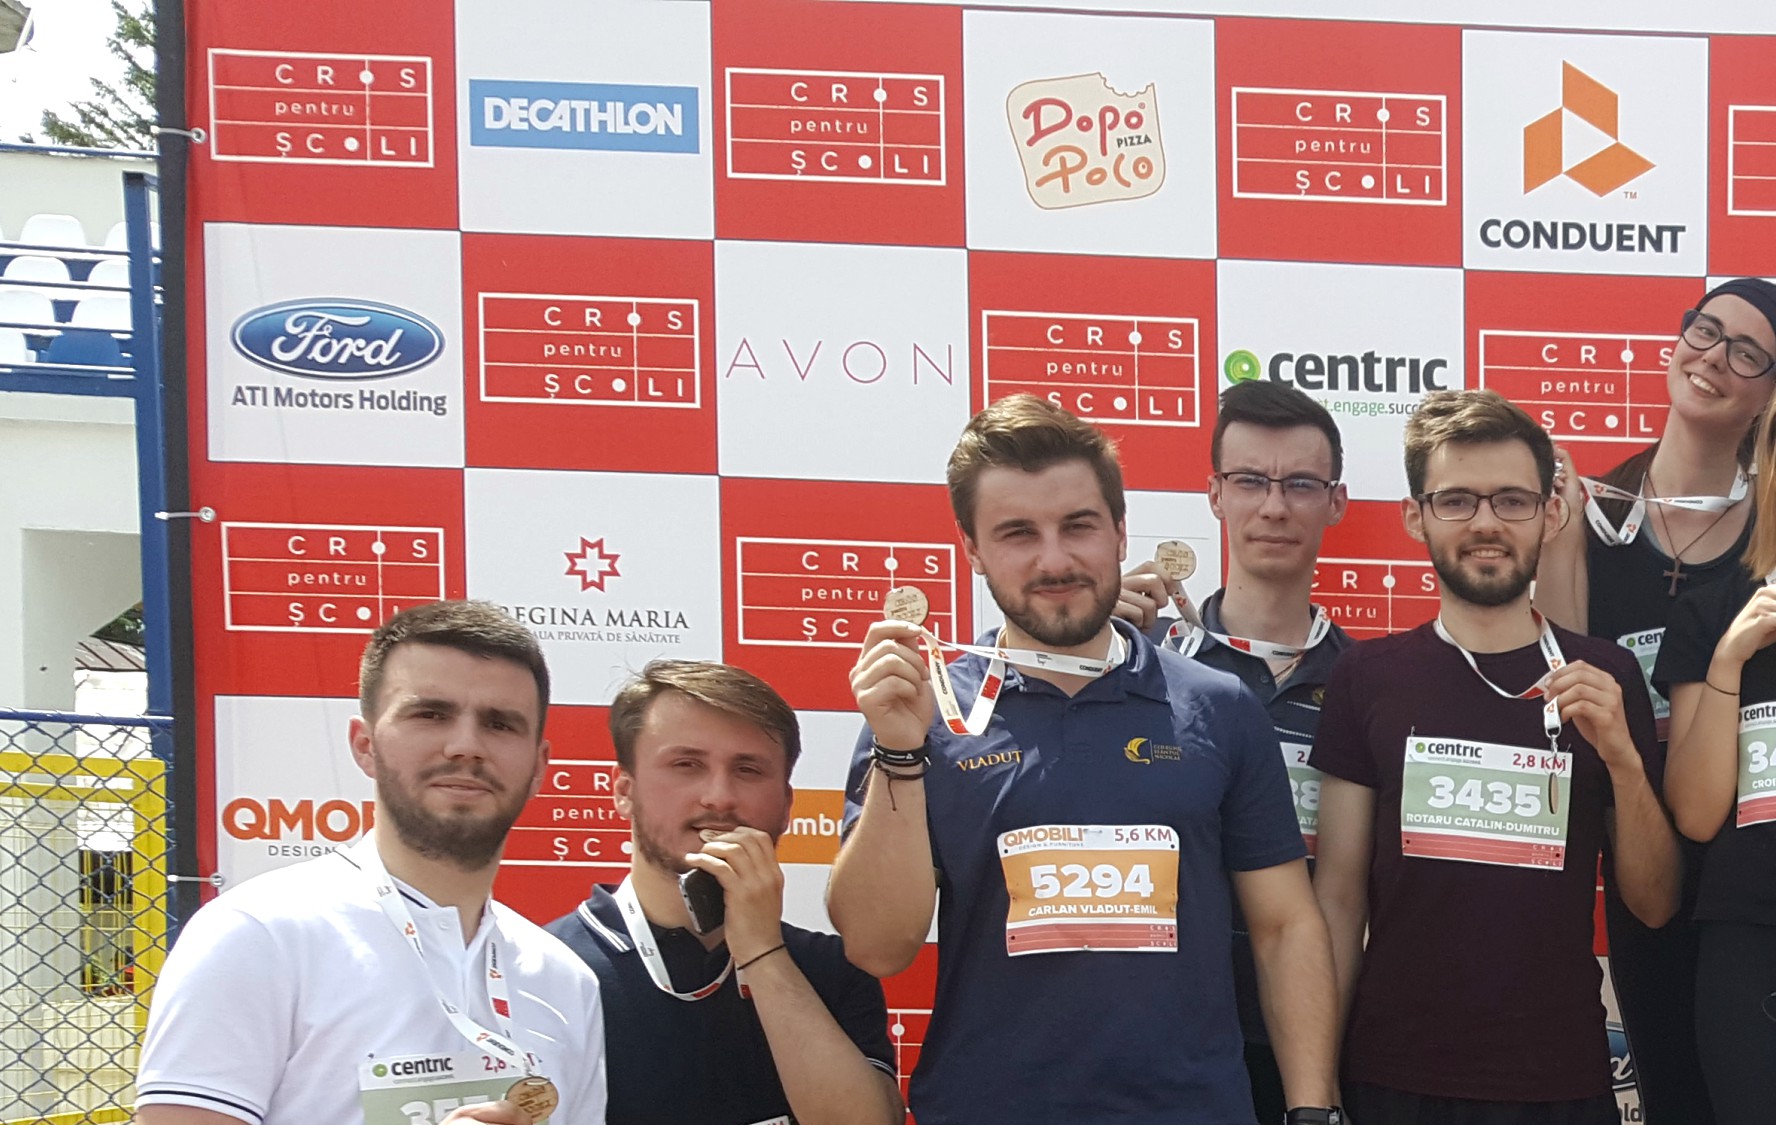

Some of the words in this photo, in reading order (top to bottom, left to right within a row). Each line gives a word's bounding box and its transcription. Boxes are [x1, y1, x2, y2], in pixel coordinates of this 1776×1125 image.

[274, 99, 356, 119] pentru
[484, 96, 683, 136] DECATHLON
[790, 117, 870, 136] pentru
[1022, 97, 1144, 157] Dopo
[1116, 134, 1152, 149] PIZZA
[1294, 137, 1373, 155] pentru
[1479, 218, 1686, 254] CONDUENT
[270, 310, 402, 367] Ford
[543, 340, 624, 360] pentru
[725, 338, 954, 386] AVON
[1046, 358, 1124, 377] pentru
[1268, 350, 1448, 394] centric
[1540, 377, 1616, 395] pentru
[231, 384, 269, 408] ATI
[274, 387, 354, 412] Motors
[359, 389, 447, 416] Holding
[287, 570, 368, 588] pentru
[801, 586, 879, 604] pentru
[605, 608, 691, 630] MARIA
[1321, 600, 1379, 618] entru
[606, 632, 623, 643] DE
[956, 749, 1023, 772] VLADUT
[1427, 741, 1483, 759] centric
[1512, 753, 1536, 770] 2,8
[1427, 775, 1542, 818] 3435
[1406, 812, 1452, 827] ROTARU
[1454, 816, 1561, 837] CATALIN-DUMITRU
[1003, 827, 1084, 848] QMOBILI
[1114, 827, 1140, 845] 5,6
[1144, 827, 1173, 843] KM
[267, 844, 334, 858] DESIGN
[1029, 863, 1155, 900] 5294
[1028, 904, 1077, 918] CARLAN
[1079, 904, 1159, 915] VLADUT-EMIL
[391, 1057, 454, 1077] centric
